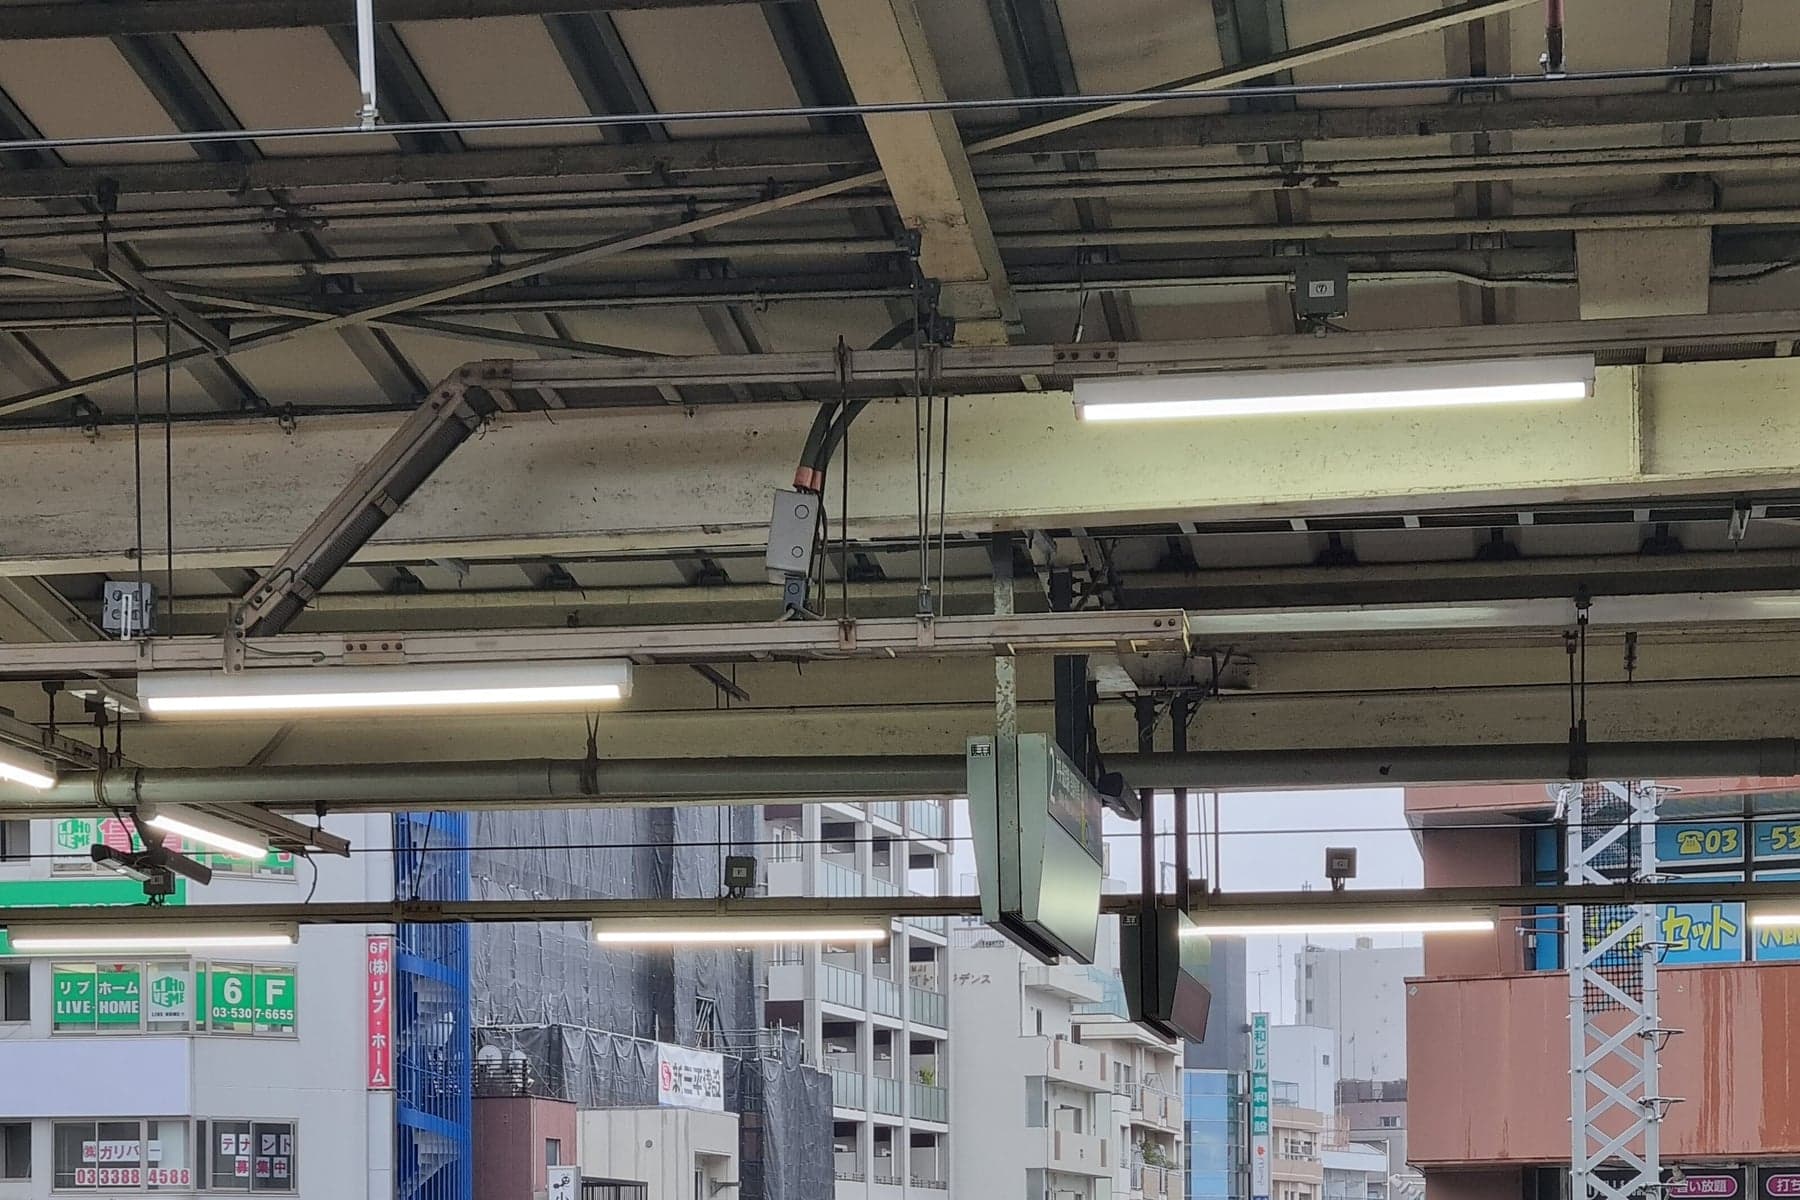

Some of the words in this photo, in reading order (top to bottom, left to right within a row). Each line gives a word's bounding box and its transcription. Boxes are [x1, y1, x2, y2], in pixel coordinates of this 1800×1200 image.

[1662, 905, 1737, 951] セット
[370, 942, 387, 953] 6F
[222, 1138, 291, 1153] テナント
[236, 1159, 288, 1175] 募集中
